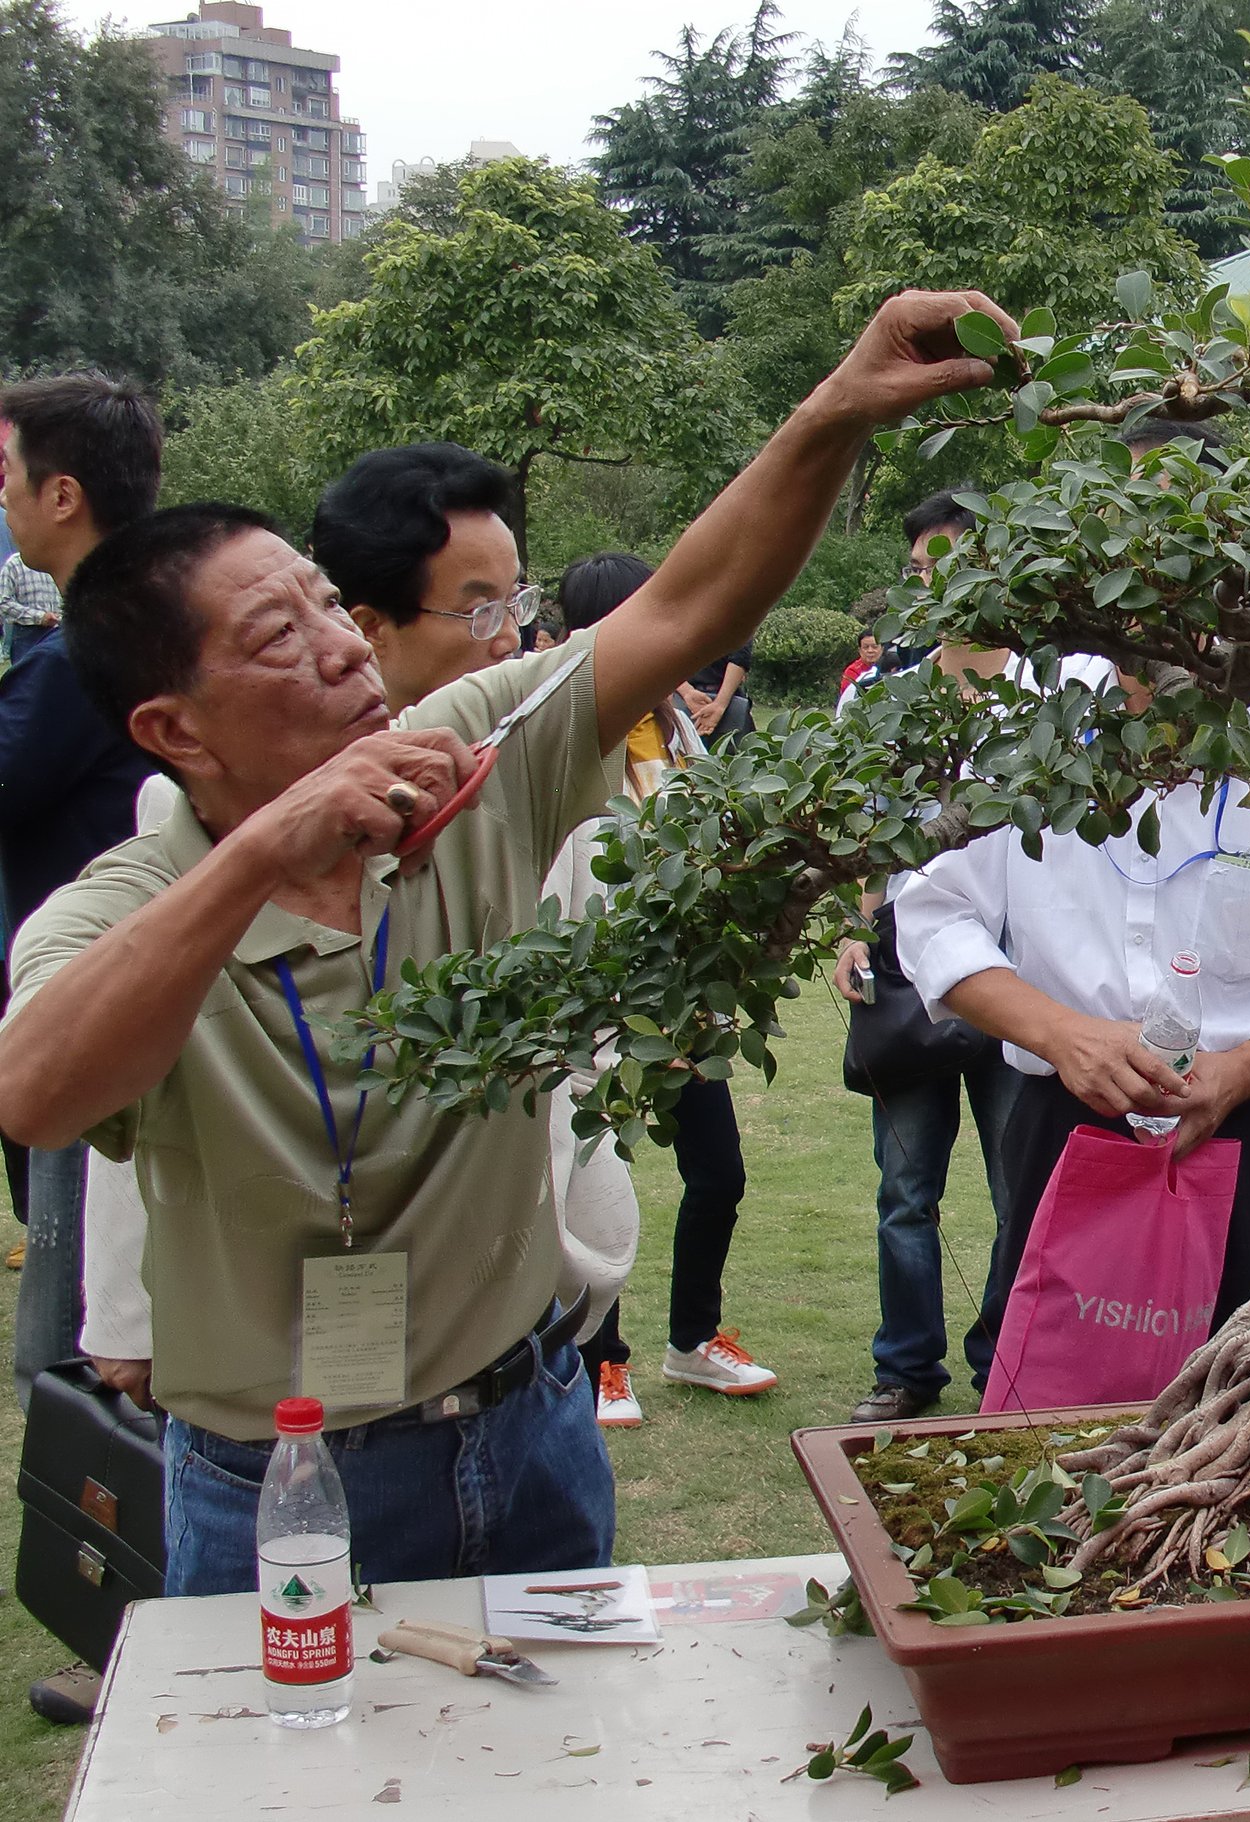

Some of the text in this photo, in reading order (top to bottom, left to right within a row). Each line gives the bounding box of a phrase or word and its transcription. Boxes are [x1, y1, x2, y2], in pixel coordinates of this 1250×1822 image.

[267, 1626, 336, 1648] 农夫山泉
[267, 1645, 336, 1659] NONGFU SPRING
